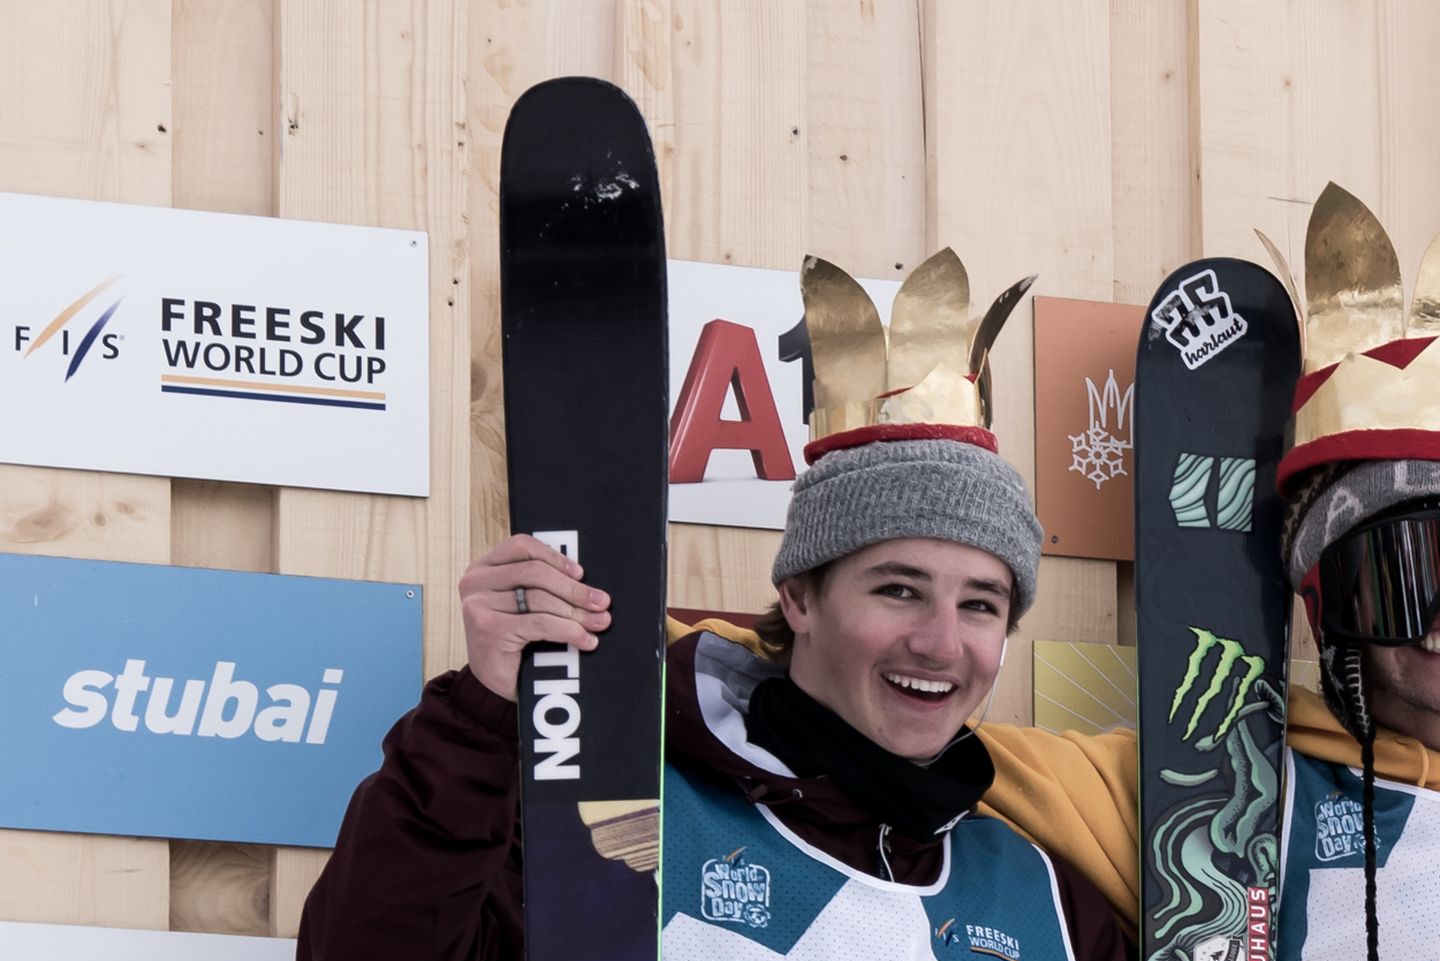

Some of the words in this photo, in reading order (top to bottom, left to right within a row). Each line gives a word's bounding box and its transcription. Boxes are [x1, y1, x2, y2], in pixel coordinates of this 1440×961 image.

[161, 297, 386, 350] FREESKI
[1185, 317, 1244, 366] harlaut
[162, 338, 303, 377] WORLD
[313, 351, 387, 384] CUP
[668, 311, 816, 485] A1
[532, 530, 581, 780] FTION
[52, 658, 344, 745] stubai
[714, 863, 758, 882] World
[711, 897, 743, 918] Day
[965, 924, 1020, 950] FREESKI
[968, 935, 1004, 953] WORLD
[1003, 946, 1021, 960] CUP
